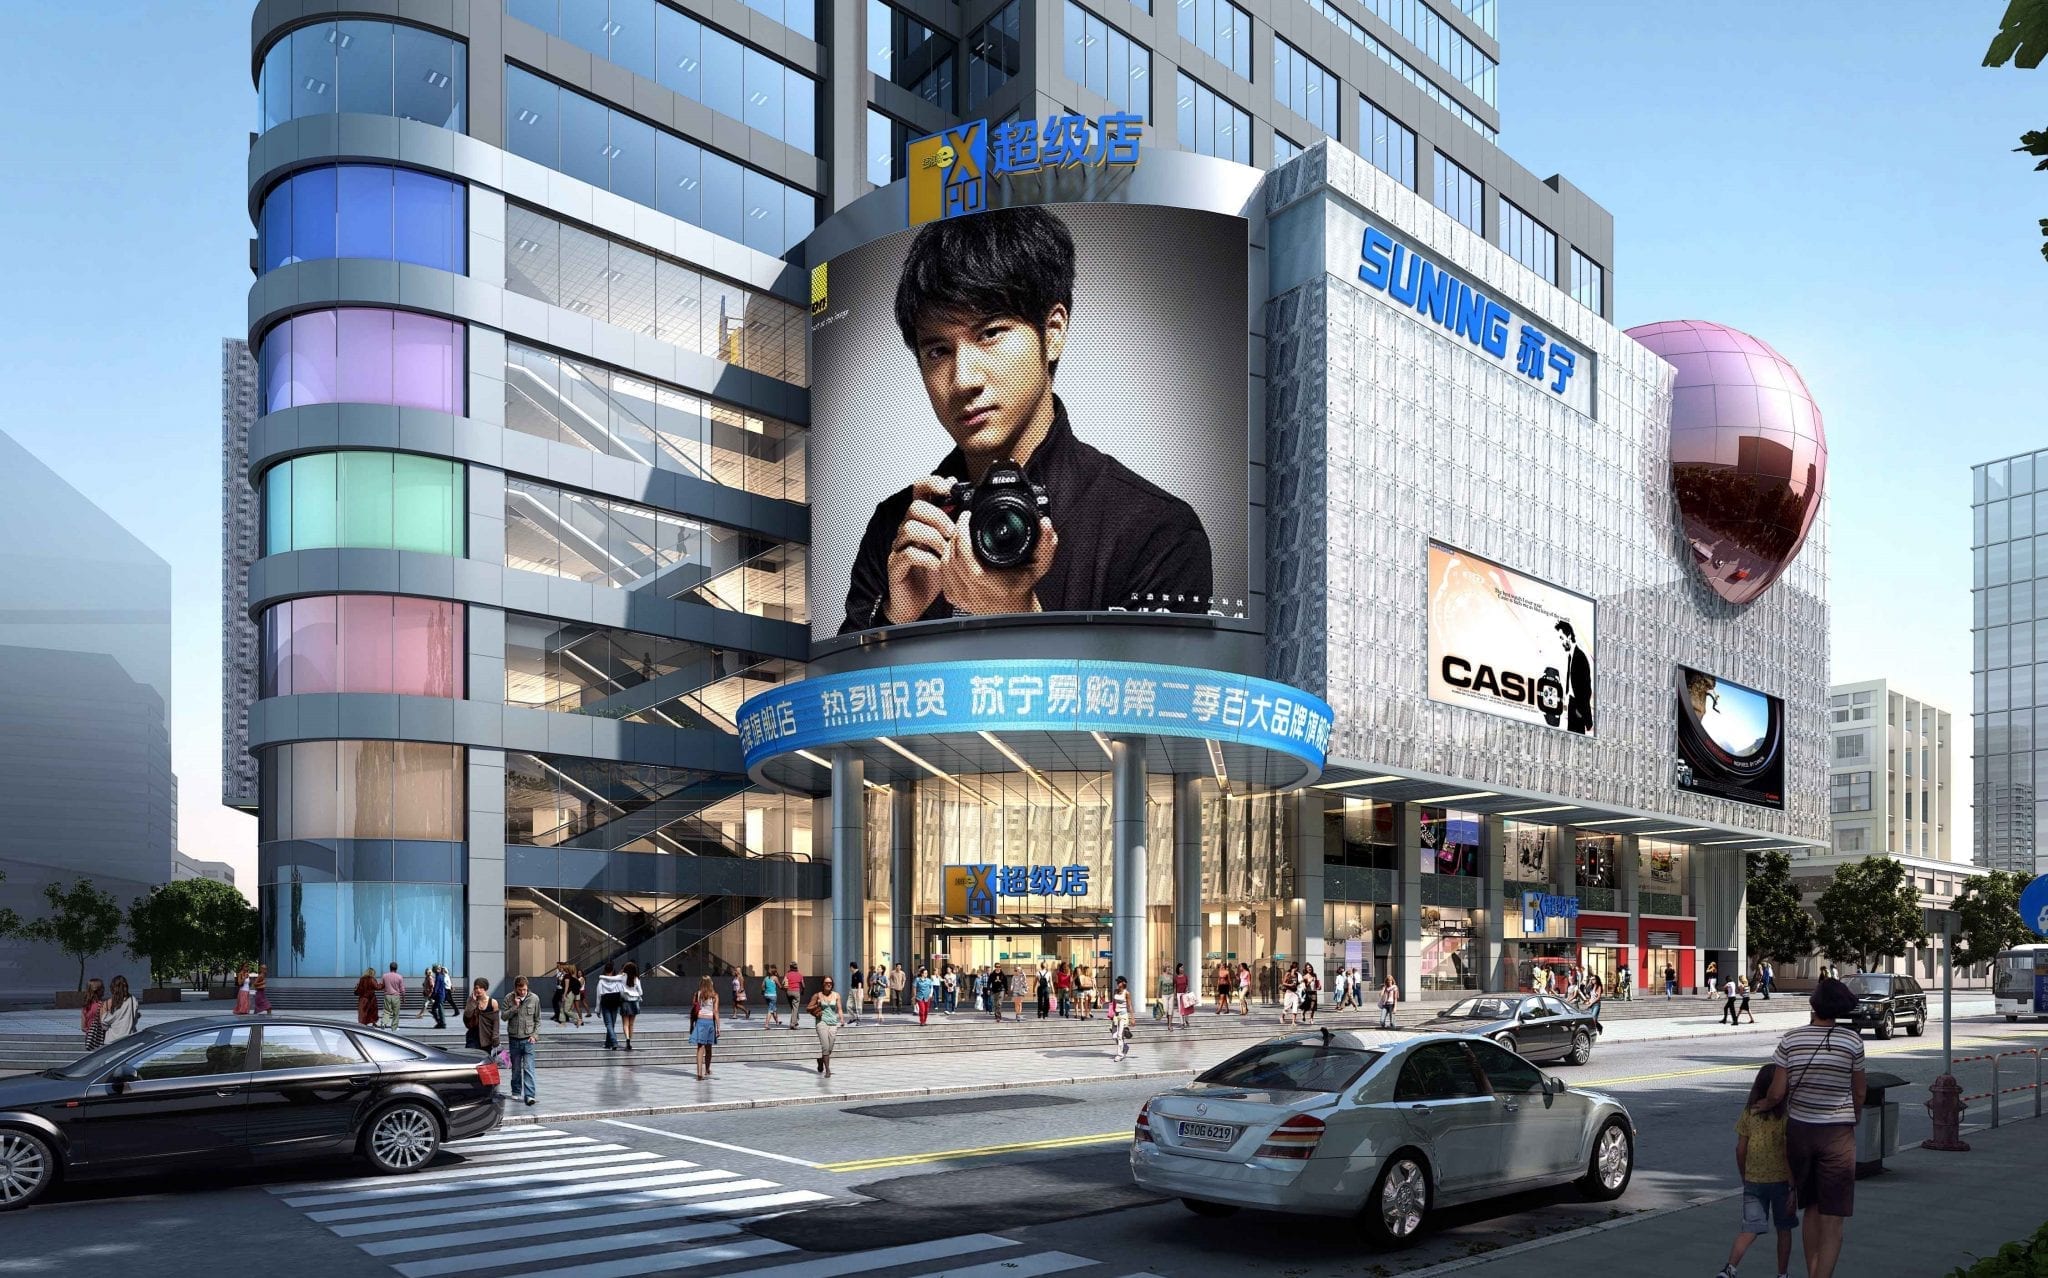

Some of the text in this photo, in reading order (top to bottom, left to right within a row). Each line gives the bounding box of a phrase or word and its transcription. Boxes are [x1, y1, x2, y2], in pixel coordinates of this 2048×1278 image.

[992, 112, 1143, 178] 超级店
[1358, 226, 1511, 360] SUNING
[1516, 324, 1576, 395] 苏宁
[821, 674, 1331, 756] 热烈祝贺 苏宁易购第二季百大品牌旗舰
[1442, 655, 1564, 717] CASIO
[740, 700, 797, 757] 牌旗舰店
[999, 864, 1090, 897] 超级店
